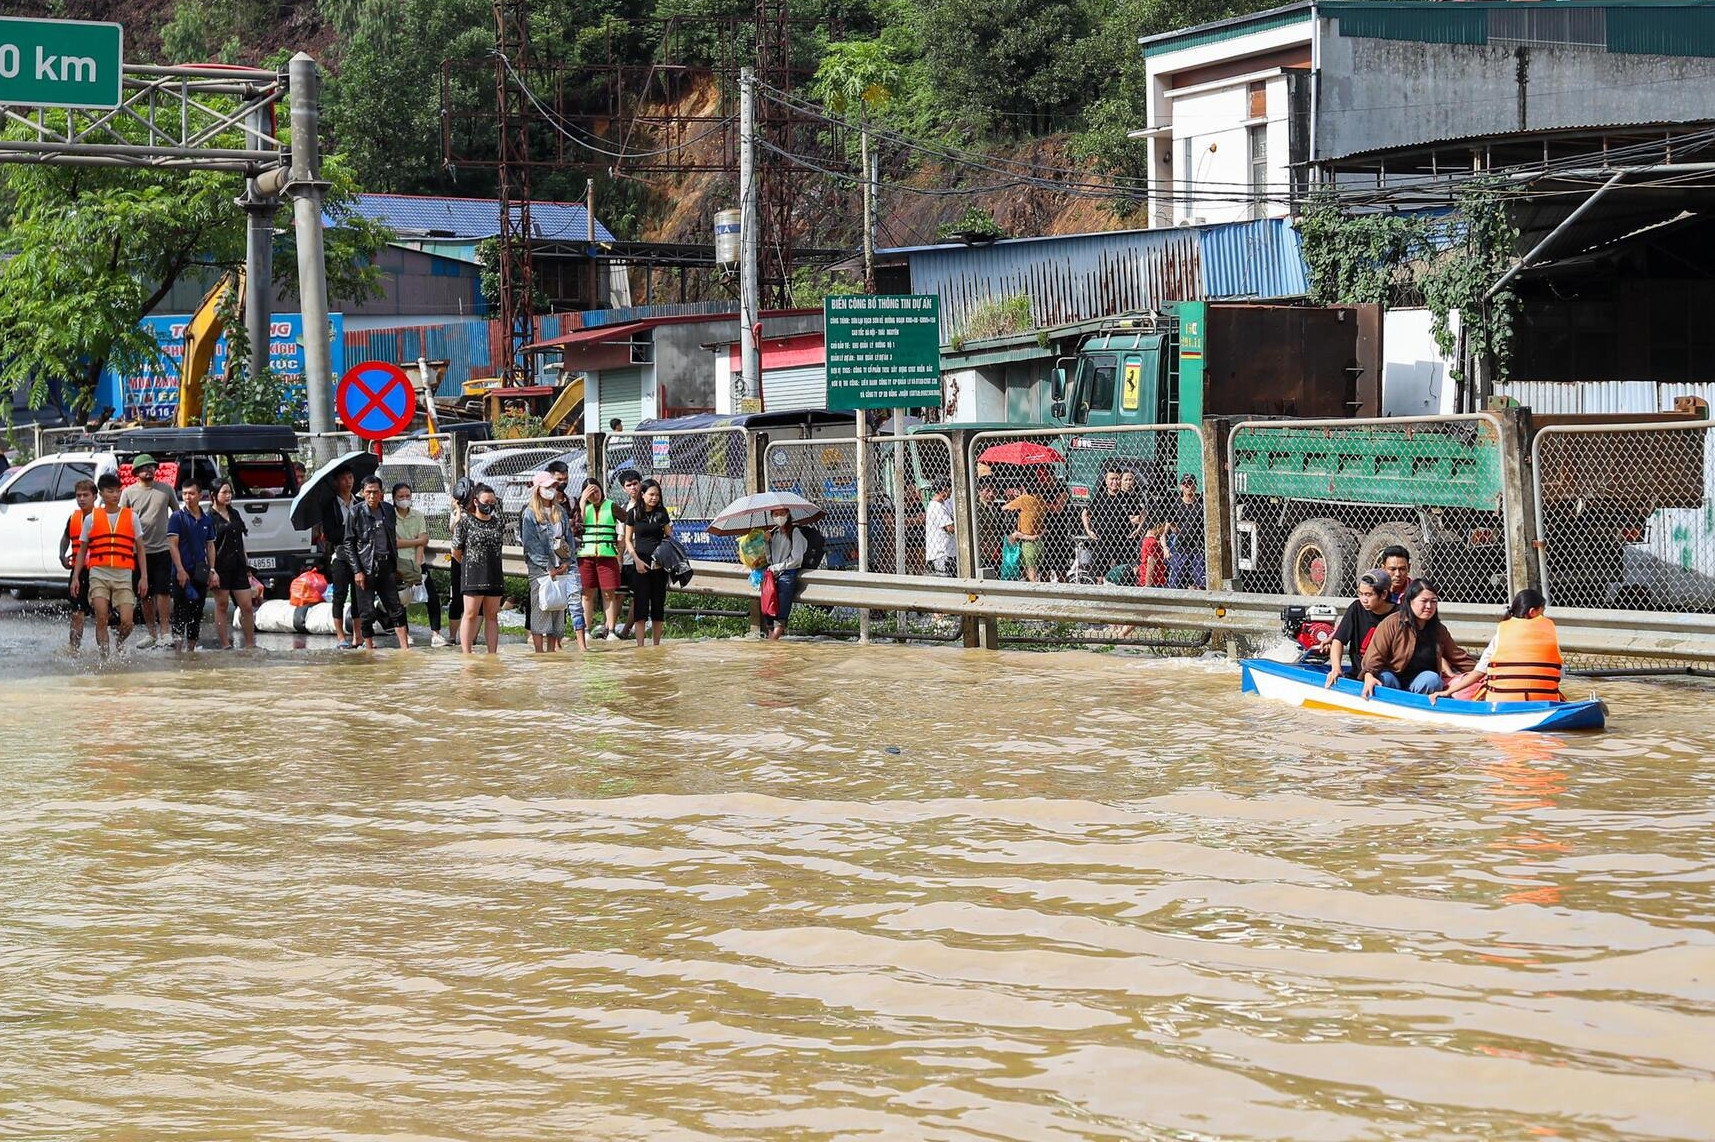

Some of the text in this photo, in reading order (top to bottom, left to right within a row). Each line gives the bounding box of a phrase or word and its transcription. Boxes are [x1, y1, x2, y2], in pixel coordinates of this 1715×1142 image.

[36, 46, 97, 82] km
[849, 297, 866, 309] CÔNG
[878, 297, 899, 309] THÔNG
[901, 299, 911, 309] TIN
